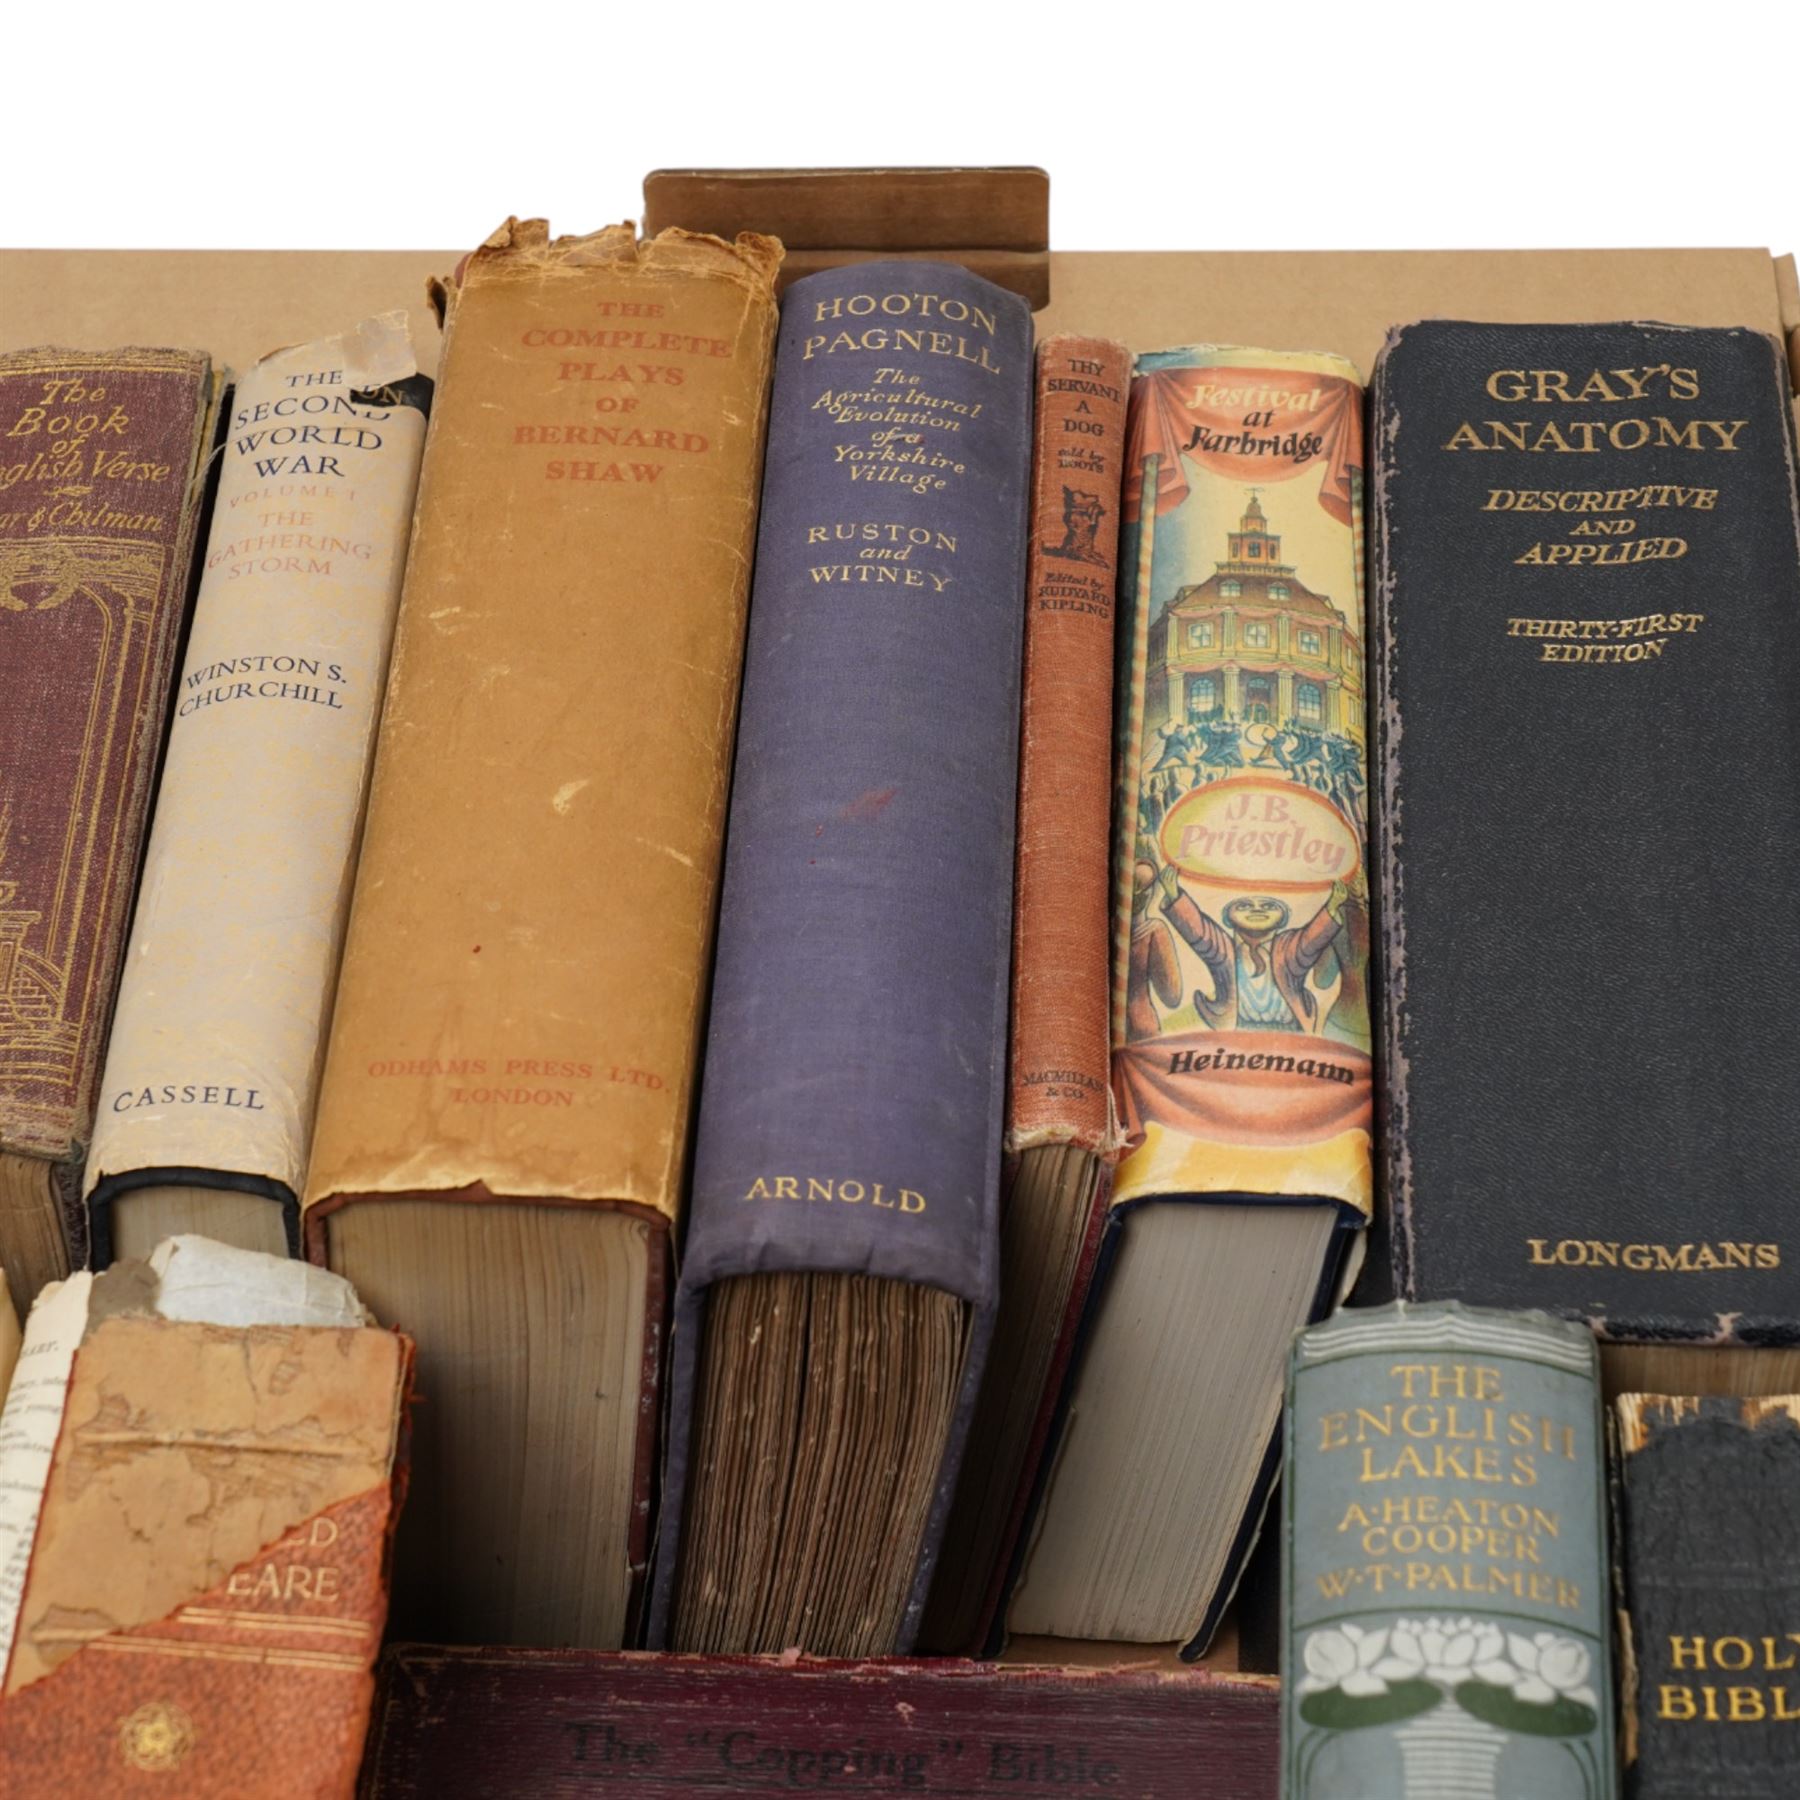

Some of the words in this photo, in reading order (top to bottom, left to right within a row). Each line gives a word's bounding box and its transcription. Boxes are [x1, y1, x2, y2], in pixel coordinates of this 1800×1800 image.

[597, 302, 664, 318] THE
[814, 293, 997, 337] HOOTON
[521, 329, 733, 358] COMPLETE
[802, 327, 1000, 375] PAGNELL
[286, 370, 344, 388] THE
[557, 362, 685, 386] PLAYS
[872, 367, 921, 385] The
[1067, 359, 1106, 377] THY
[39, 376, 107, 405] The
[1047, 378, 1122, 404] SERVANT
[1485, 363, 1701, 402] GRAY’S
[595, 397, 640, 413] OF
[810, 387, 983, 420] Agricultural
[1074, 399, 1093, 415] A
[1186, 383, 1323, 414] Festival
[5, 405, 130, 437] Book
[833, 405, 961, 433] Evolution
[1062, 419, 1105, 437] DOG
[1241, 409, 1279, 428] at
[50, 434, 90, 459] of
[235, 425, 384, 456] WORLD
[511, 425, 710, 453] BERNARD
[871, 426, 901, 448] of
[1182, 424, 1325, 465] Farbridge
[1440, 416, 1750, 452] ANATOMY
[92, 450, 171, 482] Verse
[254, 455, 346, 479] WAR
[544, 460, 665, 483] SHAW
[832, 443, 967, 474] Yorkshire
[849, 464, 948, 495] Village
[229, 485, 337, 509] VOLUME
[1480, 485, 1719, 512] DESCRIPTIVE
[27, 506, 46, 533] &
[257, 511, 315, 529] THE
[1569, 518, 1637, 536] AND
[207, 533, 373, 570] GATHERING
[807, 523, 957, 553] RUSTON
[1512, 537, 1689, 566] APPLIED
[858, 545, 914, 561] and
[227, 556, 333, 580] STORM
[806, 565, 953, 593] WITNEY
[1039, 600, 1109, 620] KIPLING
[1506, 613, 1704, 639] THIRTY-FIRST
[1539, 638, 1670, 664] EDITION
[186, 656, 320, 689] WINSTON
[327, 664, 347, 684] S.
[179, 681, 343, 717] CHURCHILL
[1176, 822, 1349, 876] Priestley
[367, 1058, 487, 1079] ODHAMS
[504, 1059, 593, 1079] PRESS
[1166, 1047, 1356, 1087] Heinemann
[113, 1085, 265, 1113] CASSELL
[451, 1087, 577, 1107] LONDON
[744, 1176, 927, 1214] ARNOLD
[1526, 1238, 1782, 1272] LONGMANS
[1390, 1364, 1505, 1401] THE
[1317, 1403, 1577, 1461] ENGLISH
[1358, 1443, 1538, 1486] LAKES
[1361, 1522, 1543, 1564] COOPER
[565, 1720, 662, 1766] The
[982, 1742, 1121, 1787] Bible
